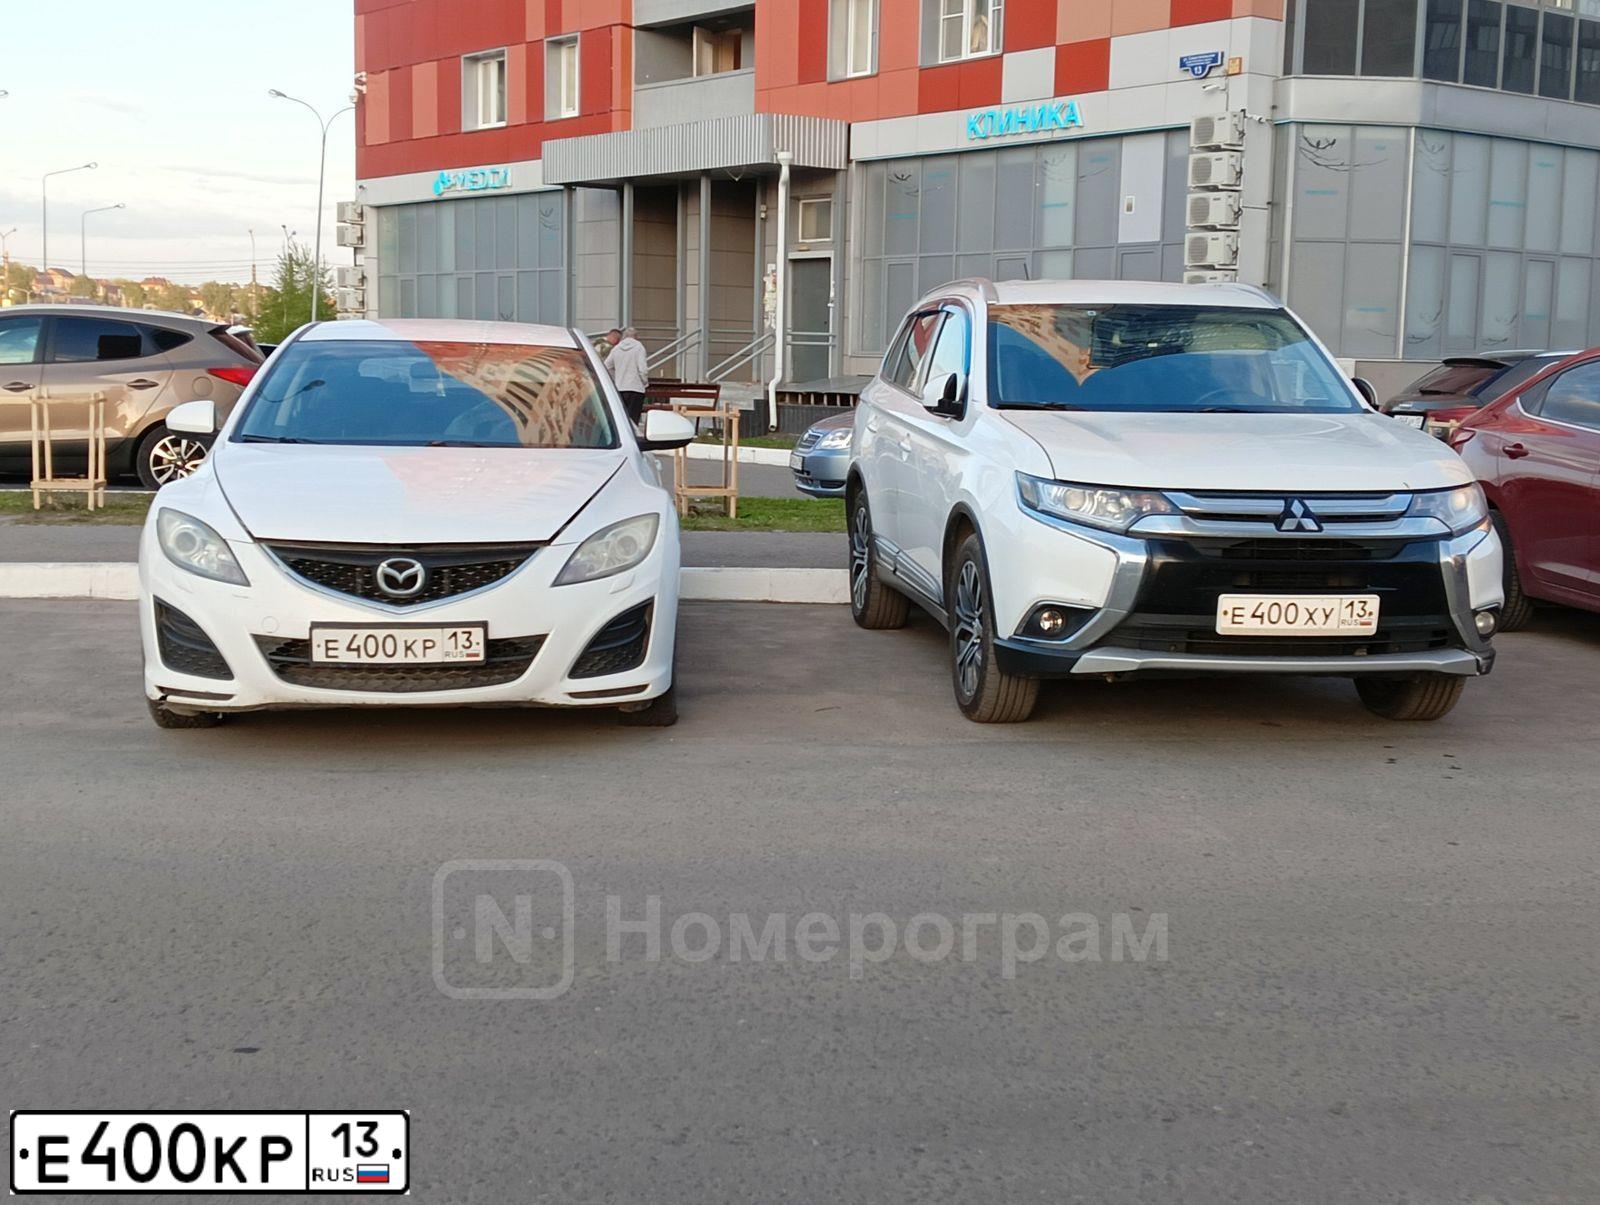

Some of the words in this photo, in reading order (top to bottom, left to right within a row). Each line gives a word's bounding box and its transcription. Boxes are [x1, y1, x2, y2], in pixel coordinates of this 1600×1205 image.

[967, 100, 1083, 139] КЛИНИКА
[1231, 602, 1334, 625] Е400ХУ
[1345, 600, 1368, 618] 13
[325, 634, 436, 658] Е400КР
[448, 631, 473, 650] 13
